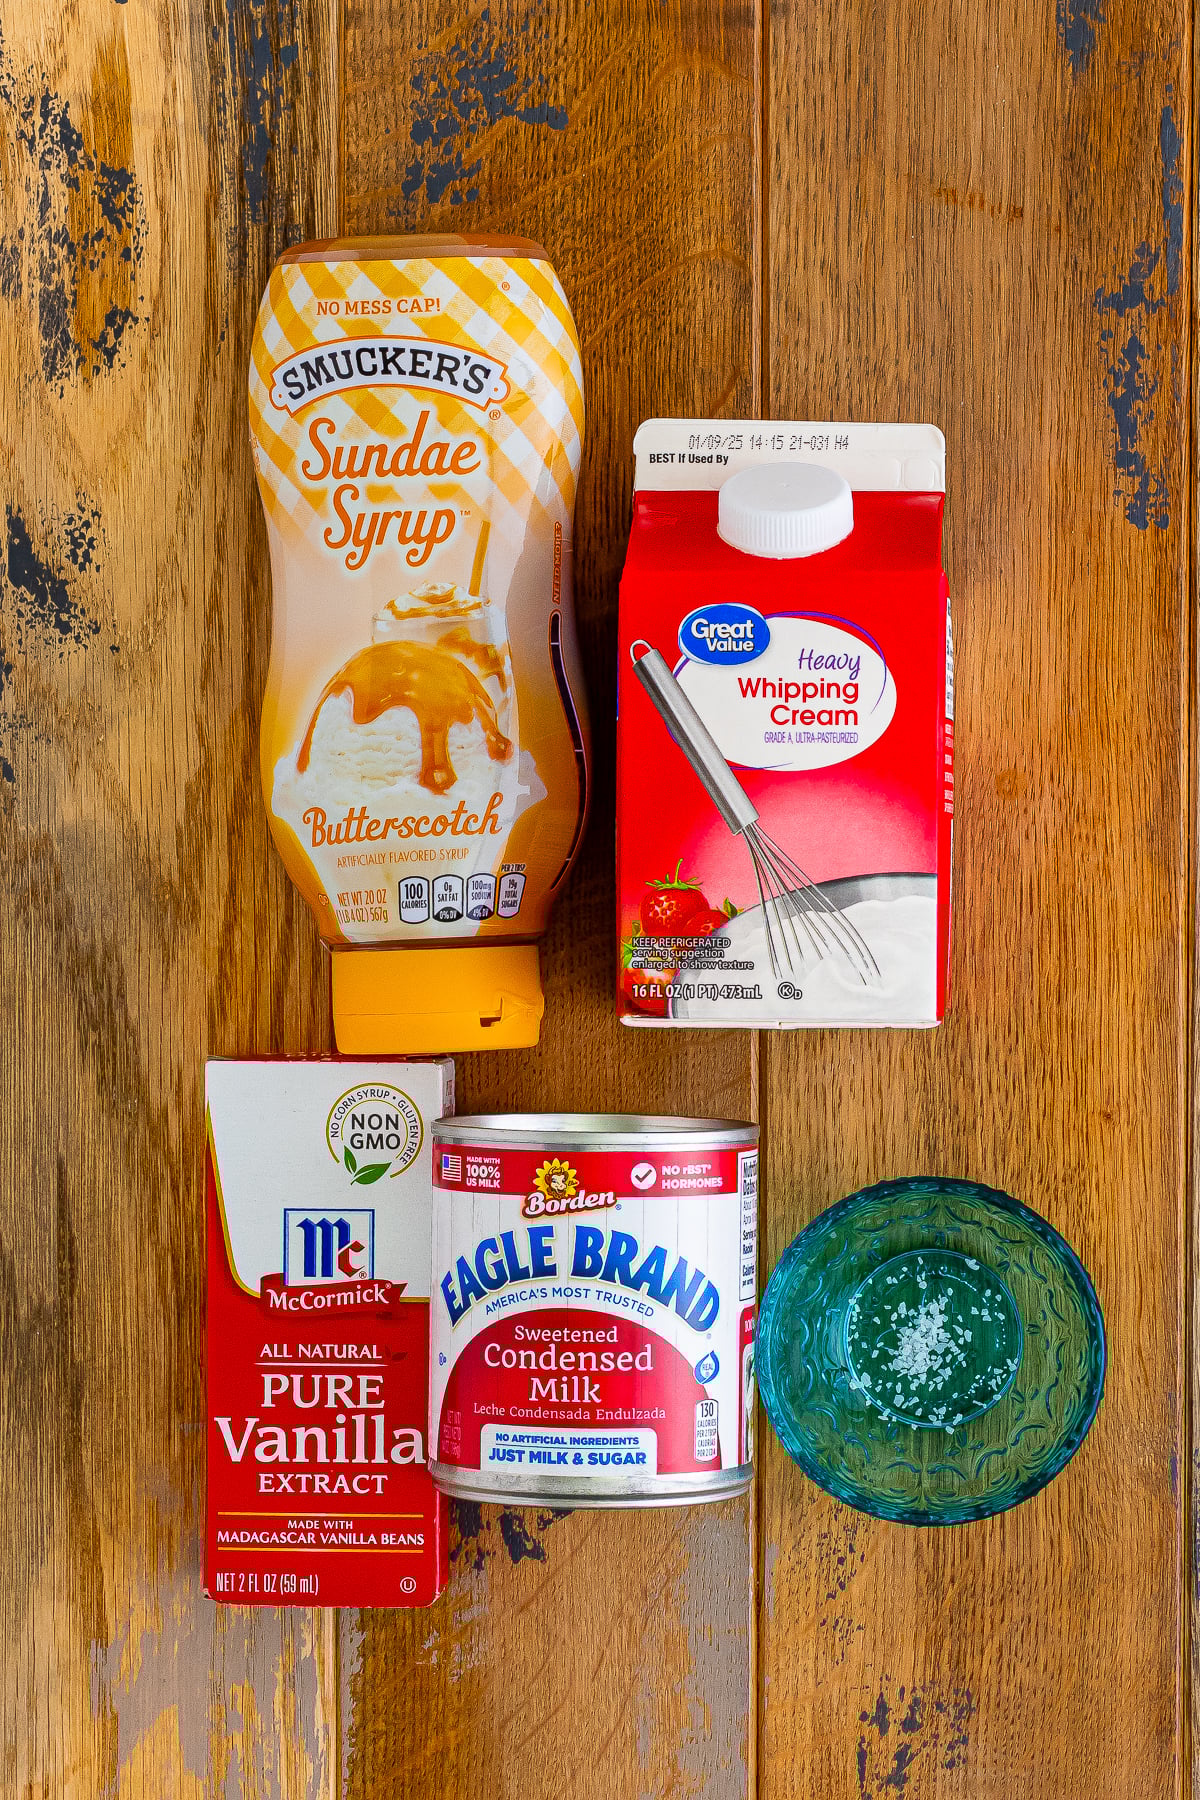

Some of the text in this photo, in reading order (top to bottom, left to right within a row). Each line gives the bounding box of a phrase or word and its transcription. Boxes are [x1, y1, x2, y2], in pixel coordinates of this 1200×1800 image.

[316, 298, 441, 316] NO MESS CAP!
[282, 347, 491, 401] SMUCKER'S
[301, 410, 481, 481] Sundae
[688, 434, 743, 449] 01/09/25
[749, 434, 784, 450] 14:15
[789, 435, 829, 450] 21-031
[649, 453, 729, 466] BEST If Used By
[323, 483, 456, 570] Syrup
[690, 618, 755, 640] Great
[706, 637, 755, 653] Value
[797, 648, 861, 681] Heavy
[737, 677, 859, 703] Whipping
[770, 704, 858, 726] Cream
[764, 731, 786, 744] GRADE
[795, 731, 859, 744] ULTRA-PASTEURIZED
[302, 792, 504, 847] Butterscotch
[337, 848, 470, 868] ARTIFICIALLY FLAVORED SYRUP
[404, 883, 423, 899] 100
[443, 882, 452, 893] 0g
[472, 880, 492, 892] 100mg
[337, 888, 387, 907] NET WT 20 OZ
[437, 892, 458, 903] SAT FAT
[471, 891, 492, 901] SODIUM
[401, 900, 428, 910] CALORIES
[439, 909, 449, 920] 0%
[632, 937, 731, 948] KEEP REFRIGERATED
[632, 949, 724, 960] serving suggestion
[632, 960, 754, 970] enlarged to show texture
[632, 984, 762, 1001] 16 FL OZ (1 PT) 473mL
[330, 1088, 419, 1165] NO CORN SYRUP GLUTEN FREE
[351, 1113, 400, 1131] NON
[350, 1133, 401, 1150] GMO
[483, 1157, 501, 1165] WITH
[466, 1164, 501, 1179] 100%
[661, 1165, 680, 1176] NO
[466, 1178, 501, 1188] US MILK
[661, 1177, 723, 1189] HORMONES
[525, 1189, 616, 1215] Borden
[440, 1225, 720, 1332] EAGLE BRAND
[266, 1283, 390, 1311] McCormick
[485, 1287, 655, 1318] AMERICA'S MOST TRUSTED
[514, 1325, 618, 1343] Sweetened
[260, 1343, 382, 1359] ALL NATURAL
[484, 1343, 653, 1372] Condensed
[261, 1373, 385, 1409] PURE
[528, 1376, 602, 1404] Milk
[473, 1402, 666, 1420] Leche Condensada Endulzada
[700, 1402, 714, 1418] 130
[213, 1413, 427, 1464] Vanilla
[495, 1432, 639, 1446] NO ARTIFICIAL INGREDIENTS
[488, 1448, 647, 1467] JUST MILK & SUGAR
[258, 1473, 389, 1494] EXTRACT
[287, 1520, 353, 1530] MADE WITH
[217, 1531, 425, 1546] MADAGASCAR VANILLA BEANS
[216, 1572, 319, 1596] NET 2 FL OZ (59 mL)
